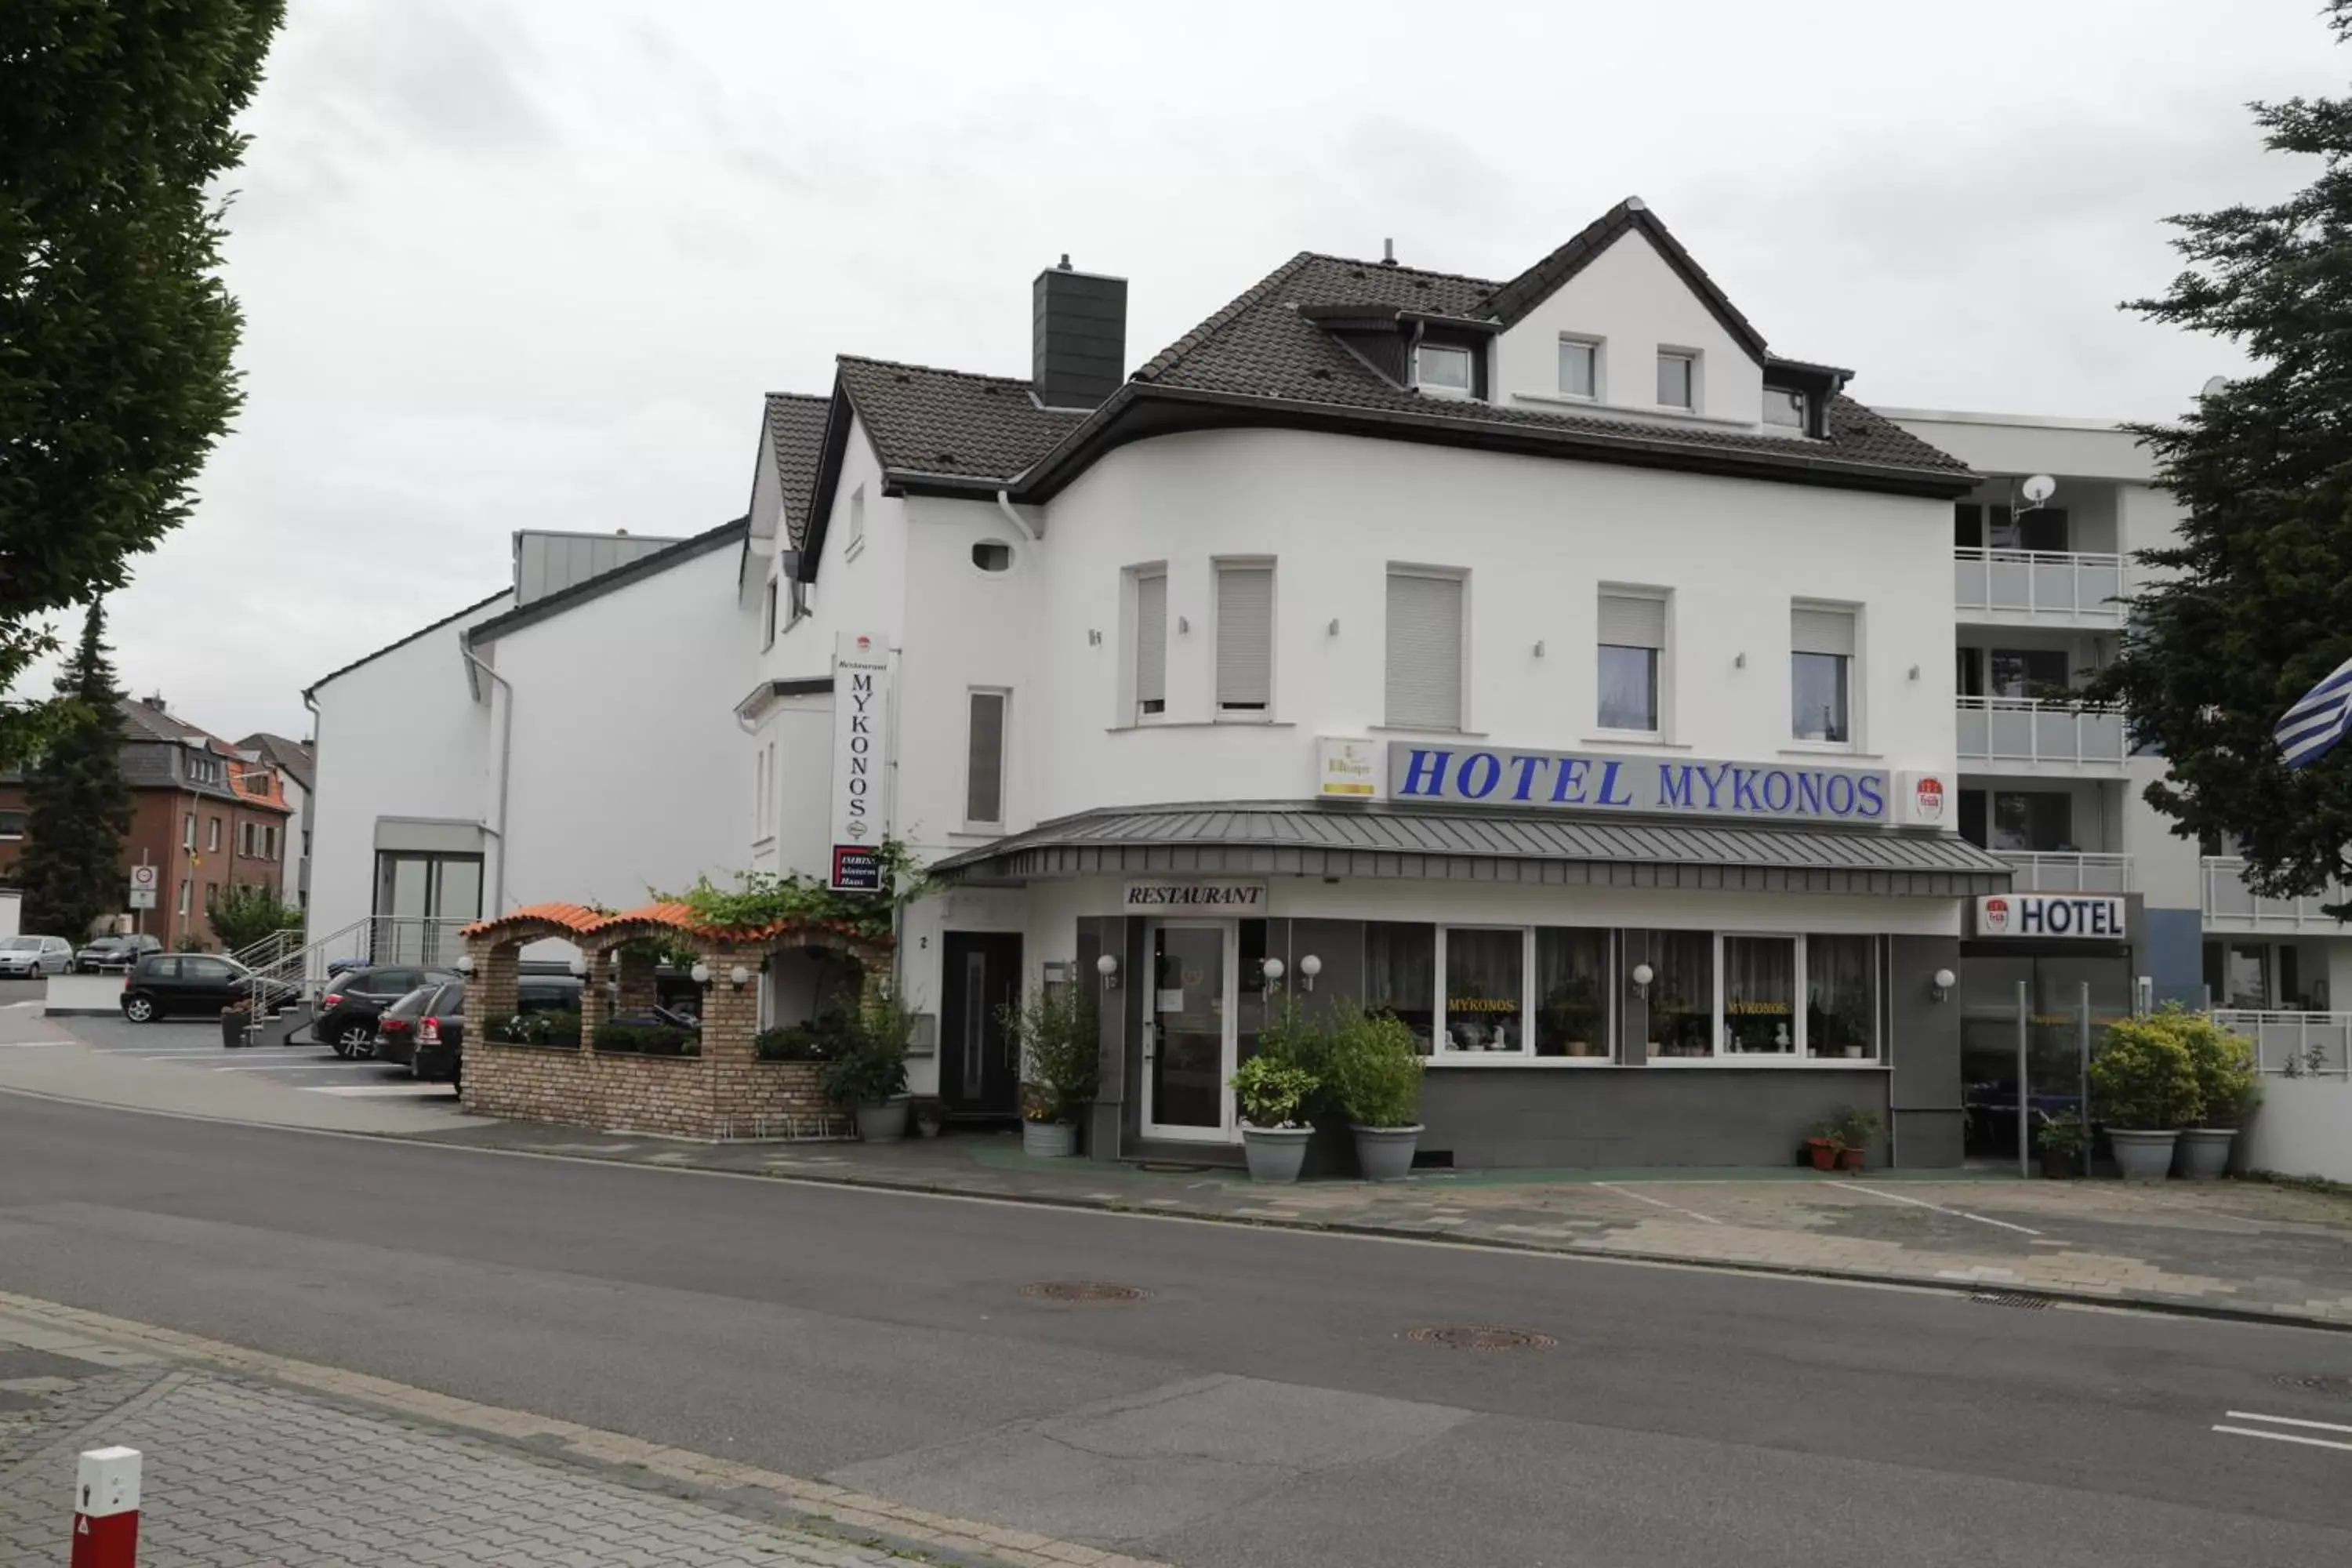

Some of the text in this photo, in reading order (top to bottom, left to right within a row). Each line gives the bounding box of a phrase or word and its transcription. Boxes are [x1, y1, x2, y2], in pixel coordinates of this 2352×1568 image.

[849, 673, 873, 817] MYKONOS
[1399, 750, 1884, 817] HOTEL MYKONOS
[1128, 886, 1264, 904] RESTAURANT
[2020, 898, 2122, 934] HOTEL
[1448, 998, 1515, 1013] MYKONOS
[1727, 1001, 1789, 1015] MYKONOS
